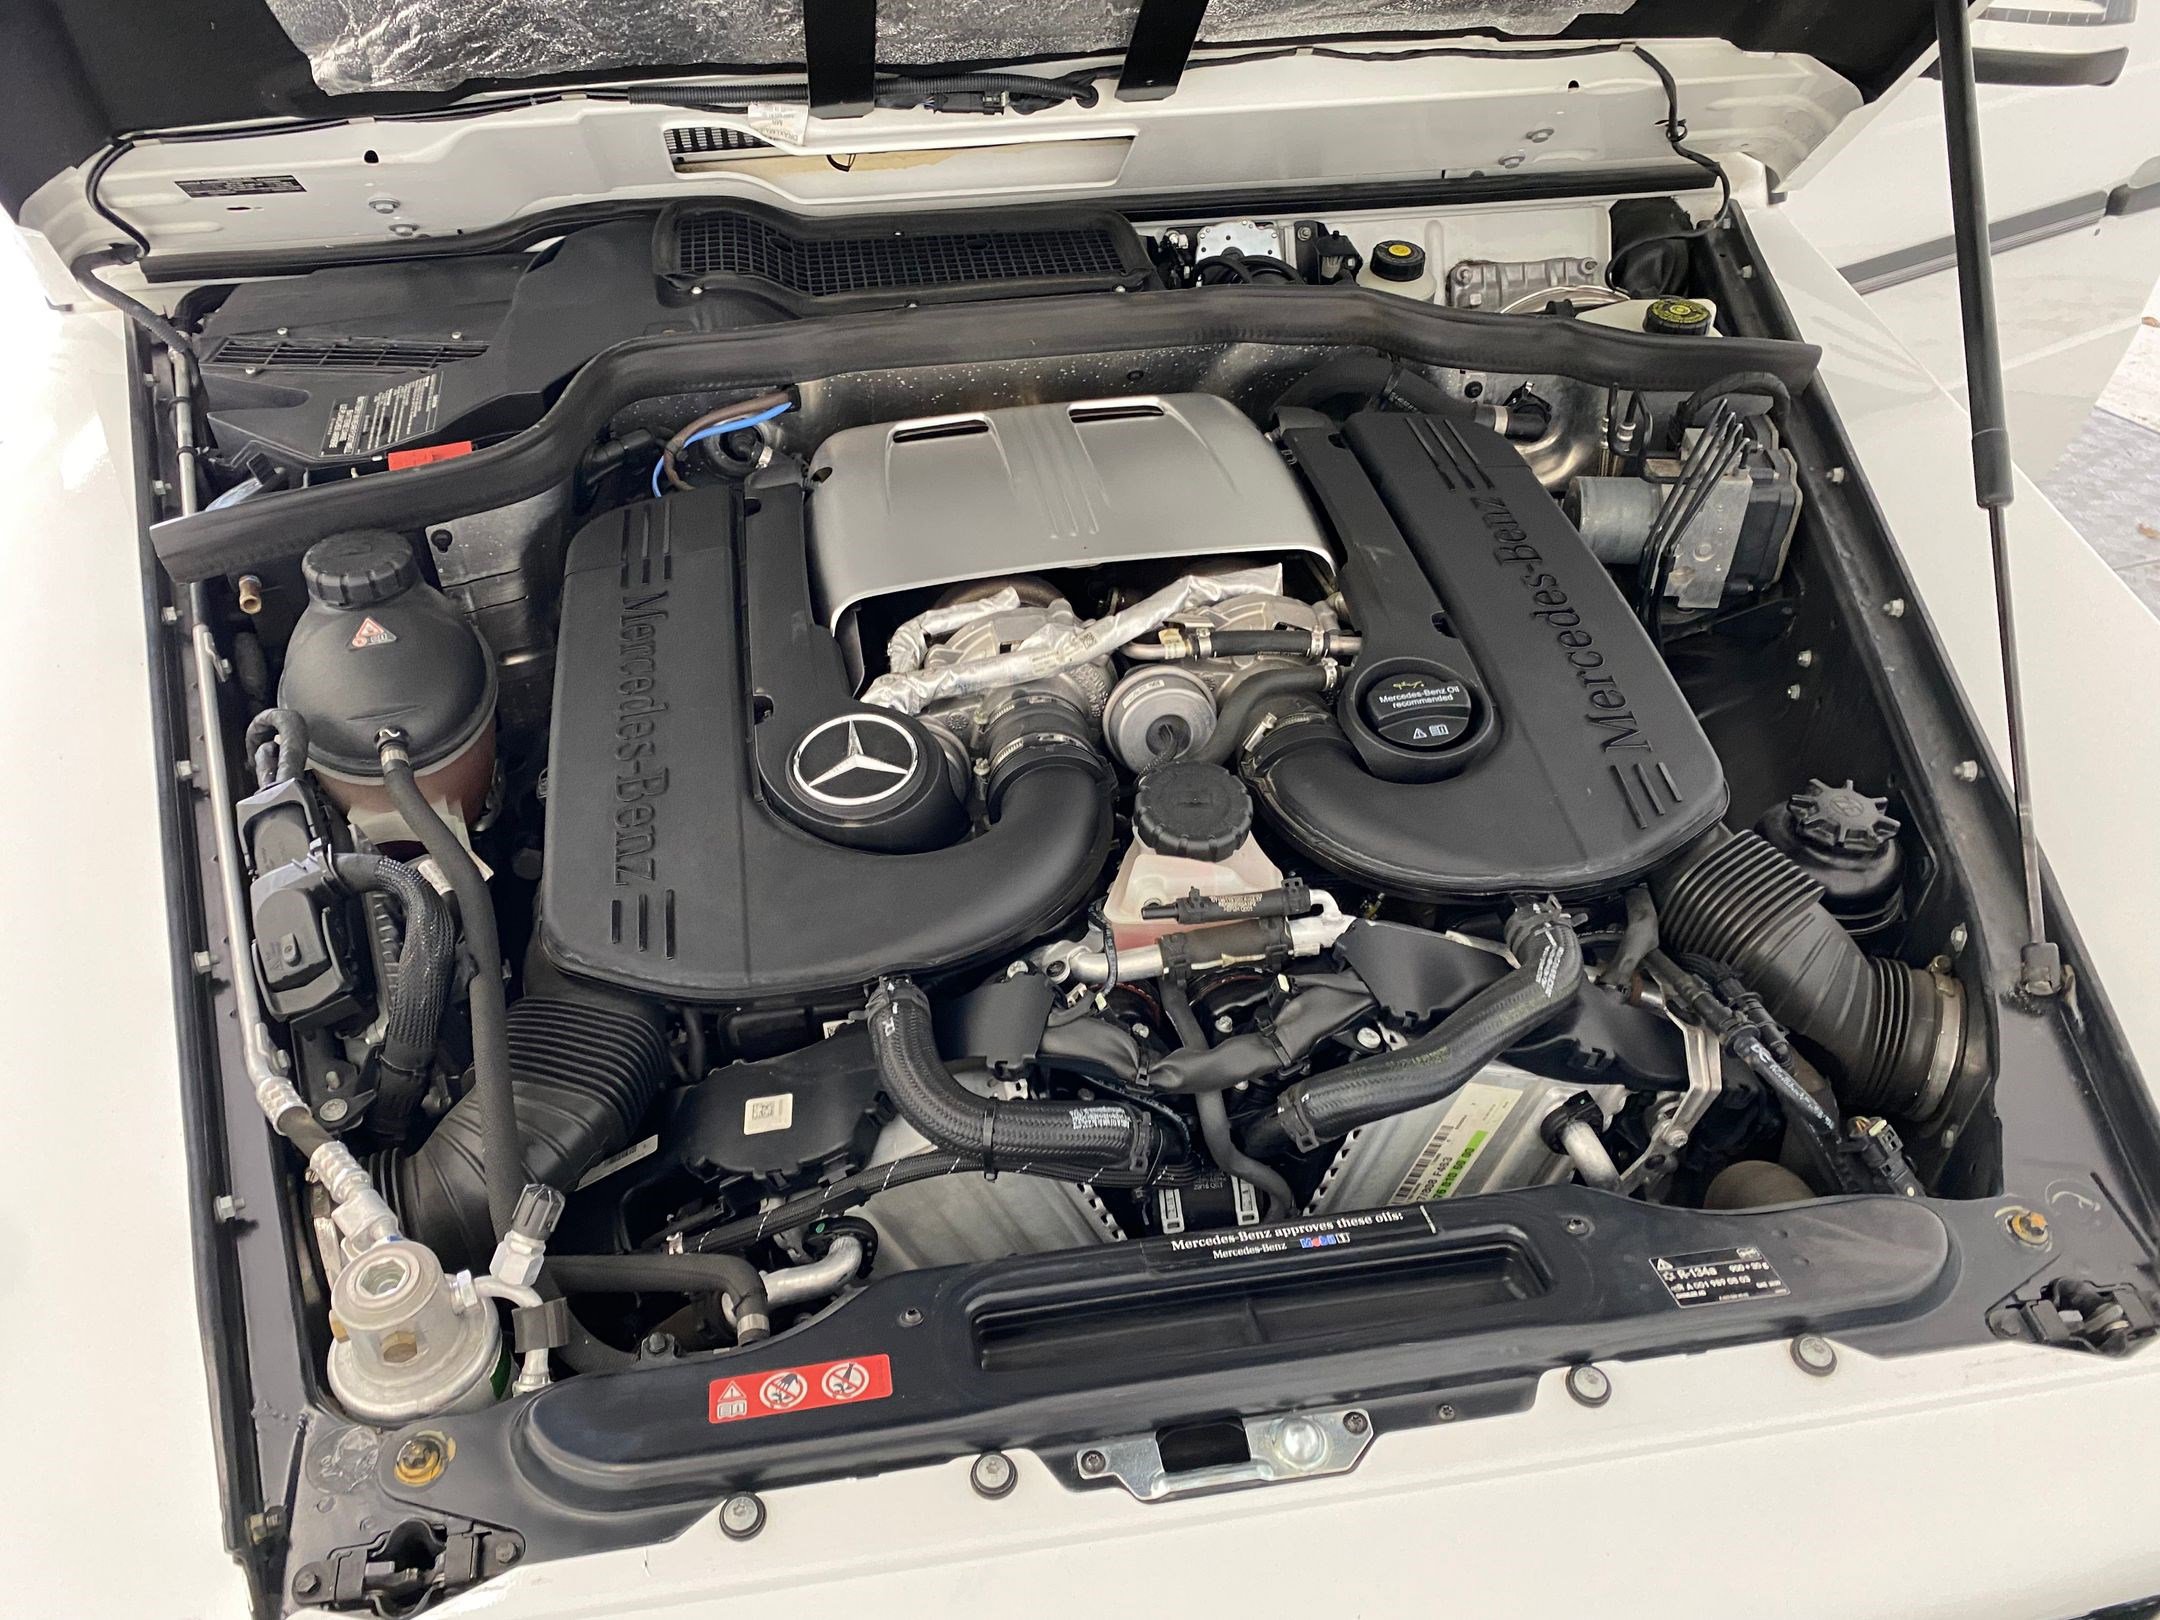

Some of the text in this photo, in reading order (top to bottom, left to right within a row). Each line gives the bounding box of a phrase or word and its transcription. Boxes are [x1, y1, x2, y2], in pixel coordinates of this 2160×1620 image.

[1470, 497, 1653, 752] Mercedes-Benz
[1378, 685, 1460, 704] Mercedes-Benz Oil
[1392, 694, 1454, 709] recommended
[614, 590, 669, 887] Mercedes-Benz
[1171, 1211, 1404, 1251] Mercedes-Benz approves these oils:
[1212, 1241, 1288, 1259] Mercedes-Benz
[1676, 1266, 1718, 1280] R-134a
